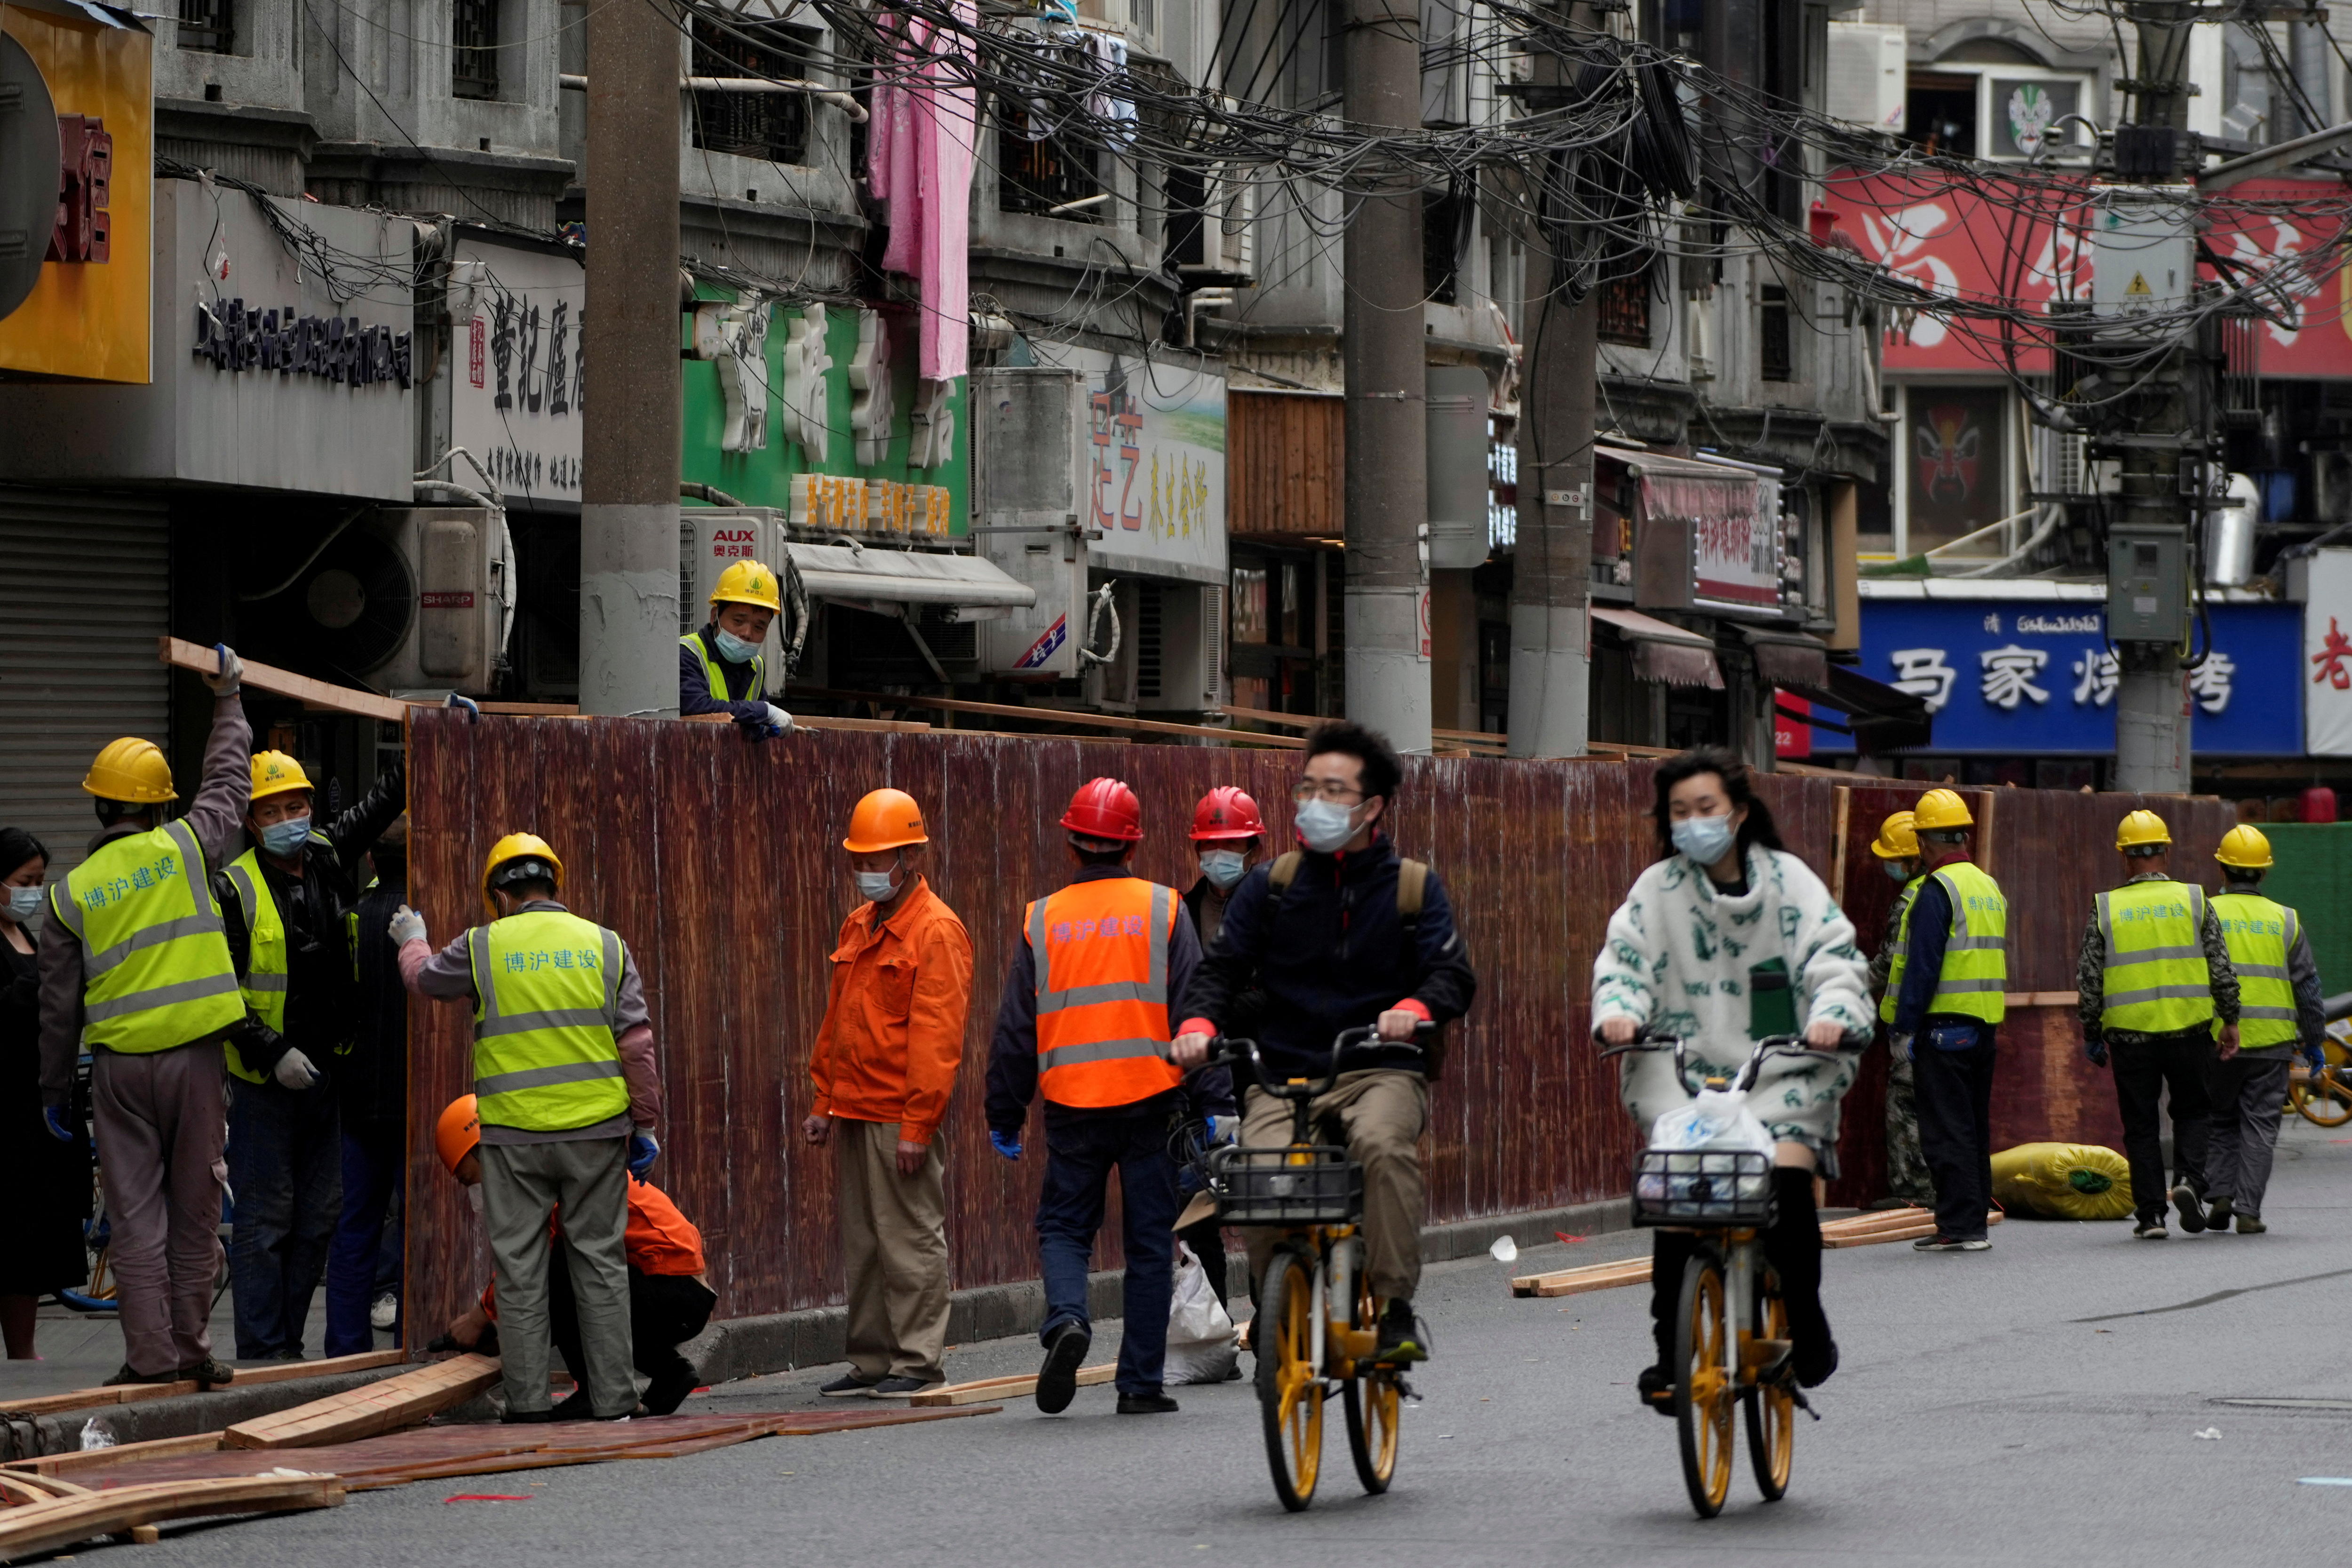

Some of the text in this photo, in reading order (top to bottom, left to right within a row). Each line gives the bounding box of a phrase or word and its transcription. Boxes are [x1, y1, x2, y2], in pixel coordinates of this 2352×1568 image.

[713, 530, 755, 542] AUX
[713, 544, 754, 557] 奥克斯
[423, 595, 471, 605] SHARP
[83, 855, 178, 912] 博沪建设
[2118, 903, 2185, 923] 博沪建设
[1051, 915, 1144, 944] 博沪建设
[504, 949, 597, 974] 博沪建设
